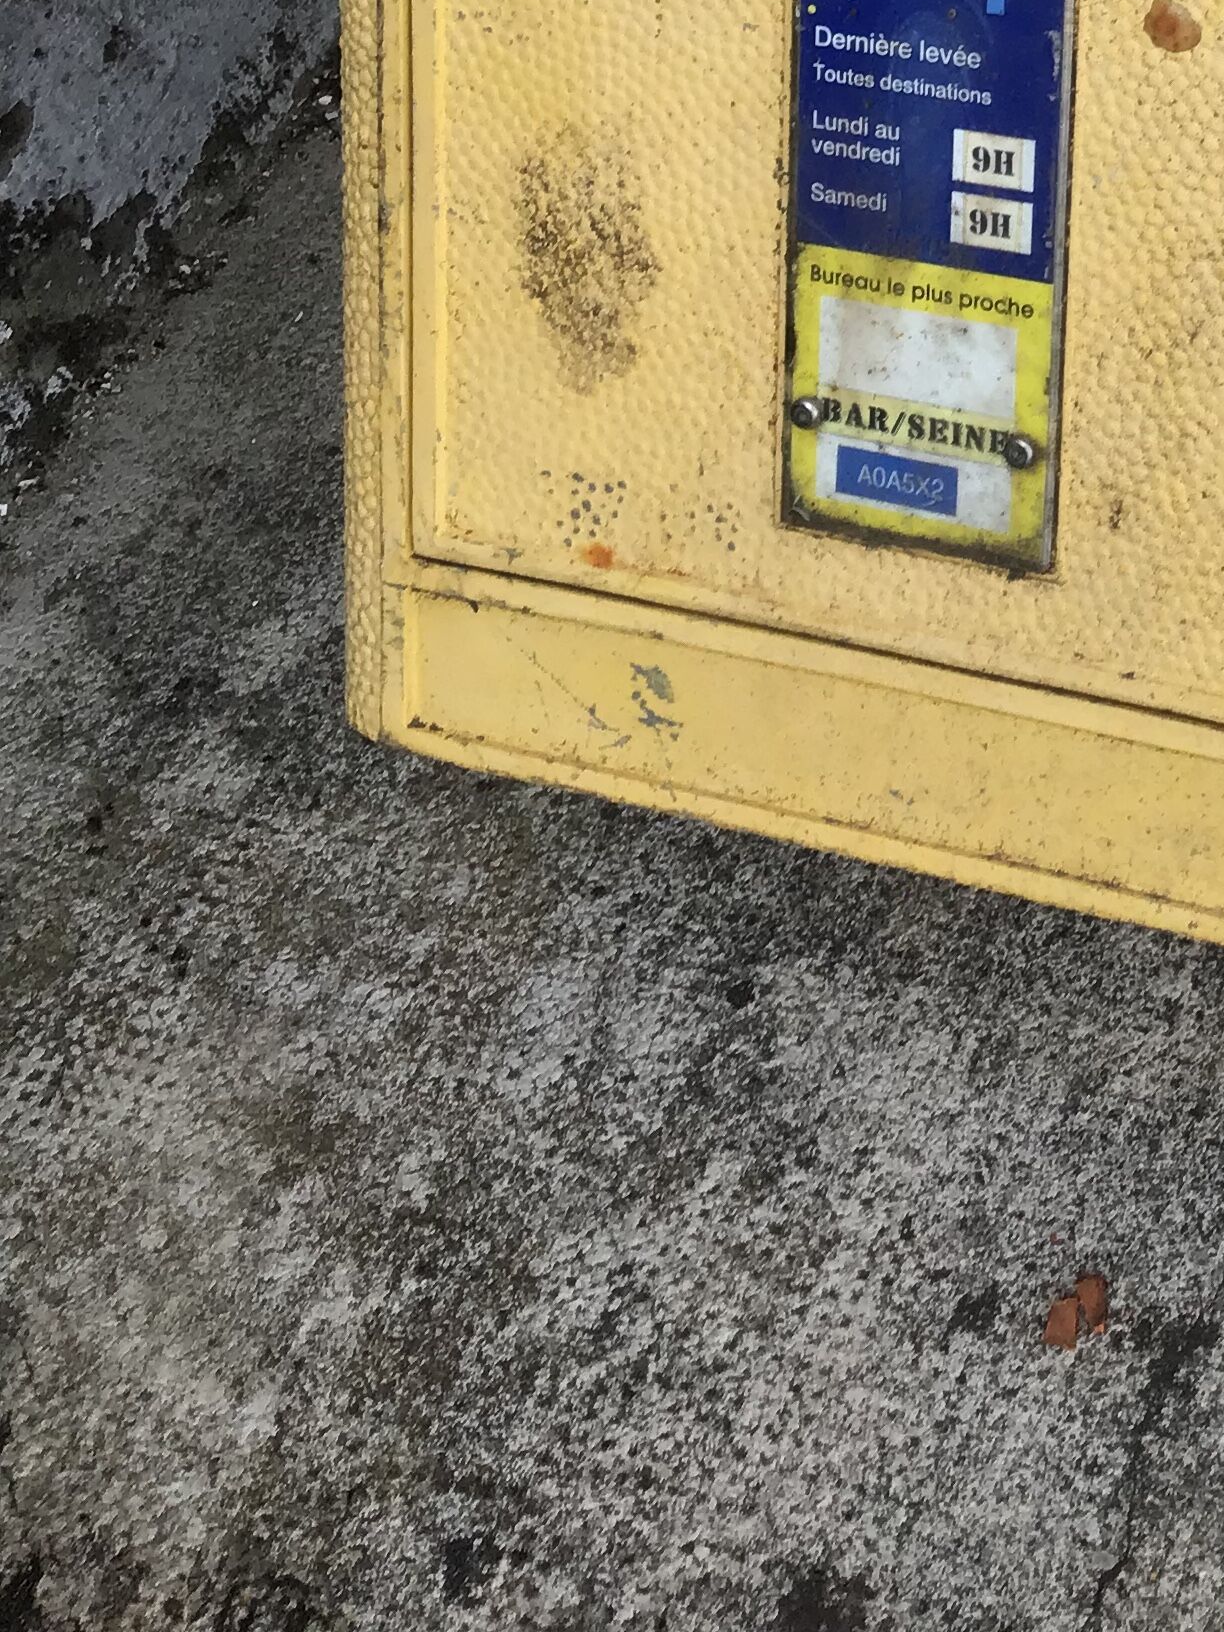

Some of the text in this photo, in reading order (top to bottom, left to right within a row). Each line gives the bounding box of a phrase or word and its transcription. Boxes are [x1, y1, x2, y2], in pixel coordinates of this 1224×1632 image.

[814, 25, 982, 70] Dernière levée
[812, 61, 992, 106] Toutes destinations
[811, 110, 900, 141] Lundi au
[811, 137, 900, 166] vendredi
[971, 146, 1016, 177] 9H
[810, 182, 888, 213] Samedi
[968, 209, 1011, 239] 9H
[810, 264, 1034, 319] Bureau le plus proche
[822, 397, 1010, 455] BAR/SEINE
